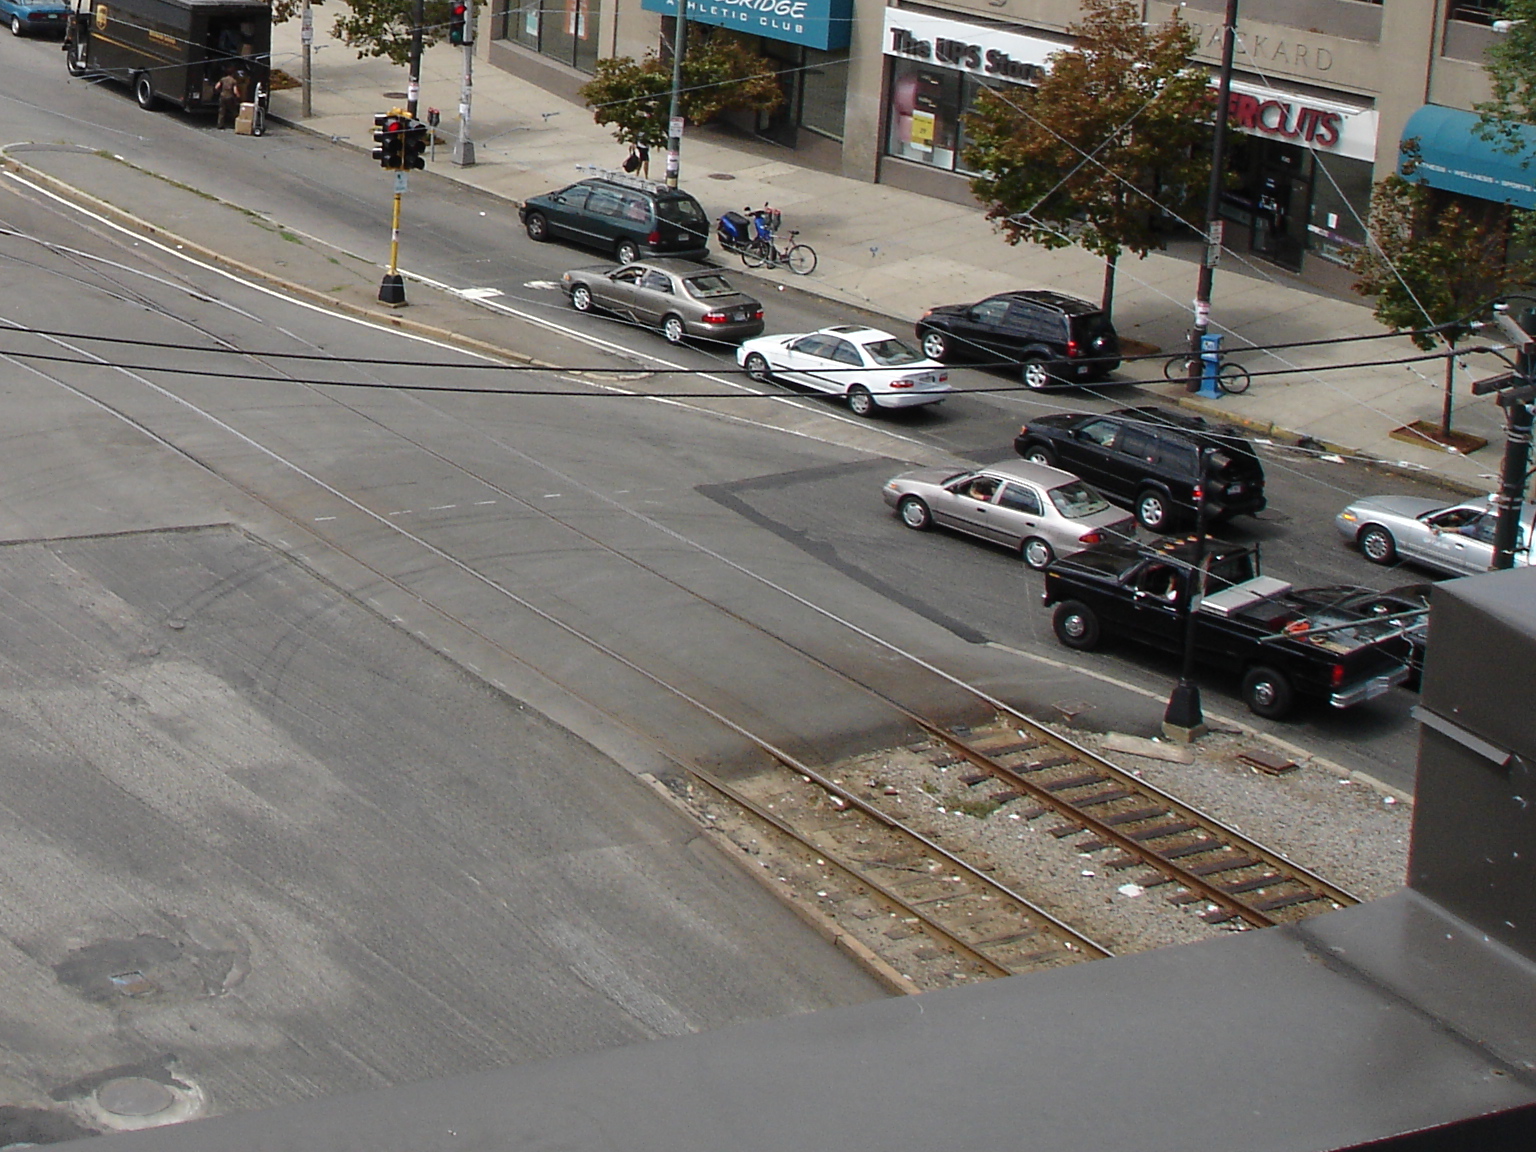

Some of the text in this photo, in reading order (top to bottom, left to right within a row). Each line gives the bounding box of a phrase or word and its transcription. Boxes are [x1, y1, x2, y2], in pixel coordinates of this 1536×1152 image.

[759, 16, 804, 34] CLUB
[890, 27, 932, 58] The
[935, 37, 983, 69] UPS
